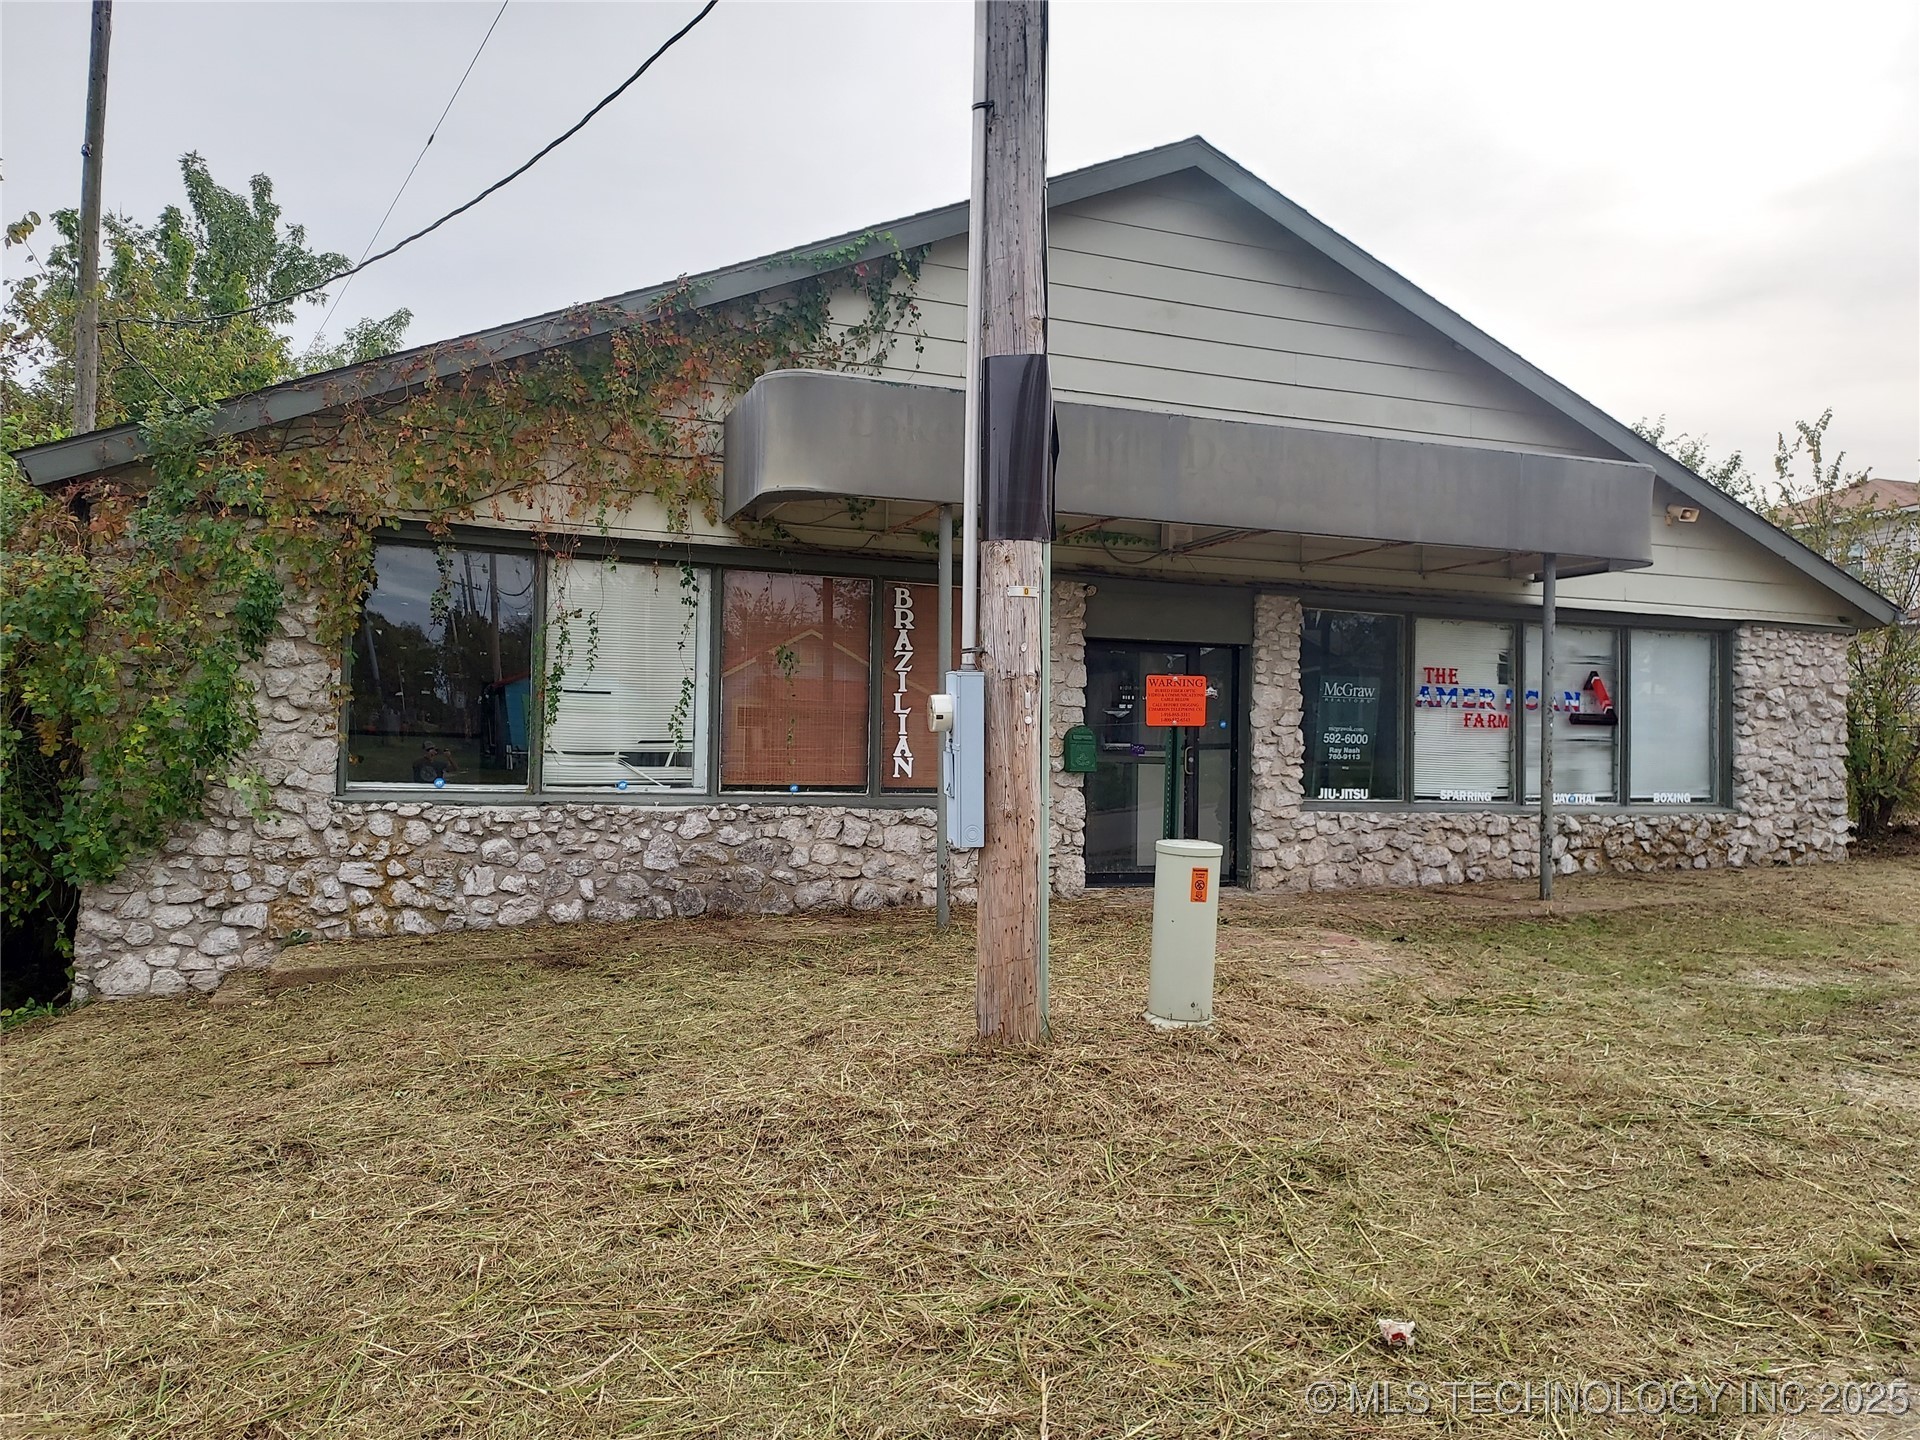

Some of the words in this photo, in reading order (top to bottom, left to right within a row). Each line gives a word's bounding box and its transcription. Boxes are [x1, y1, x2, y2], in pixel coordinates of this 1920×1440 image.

[1423, 667, 1459, 685] THE
[893, 587, 915, 778] BRAZILIAN
[1149, 679, 1204, 687] WARNING
[1324, 682, 1375, 697] McGraw
[1463, 713, 1509, 728] FARM
[1323, 733, 1368, 744] 592-6000
[1318, 787, 1369, 800] JIU-JITSU
[1440, 790, 1492, 802] SPARRING
[1552, 793, 1571, 804] UAY
[1653, 793, 1691, 803] BOXING
